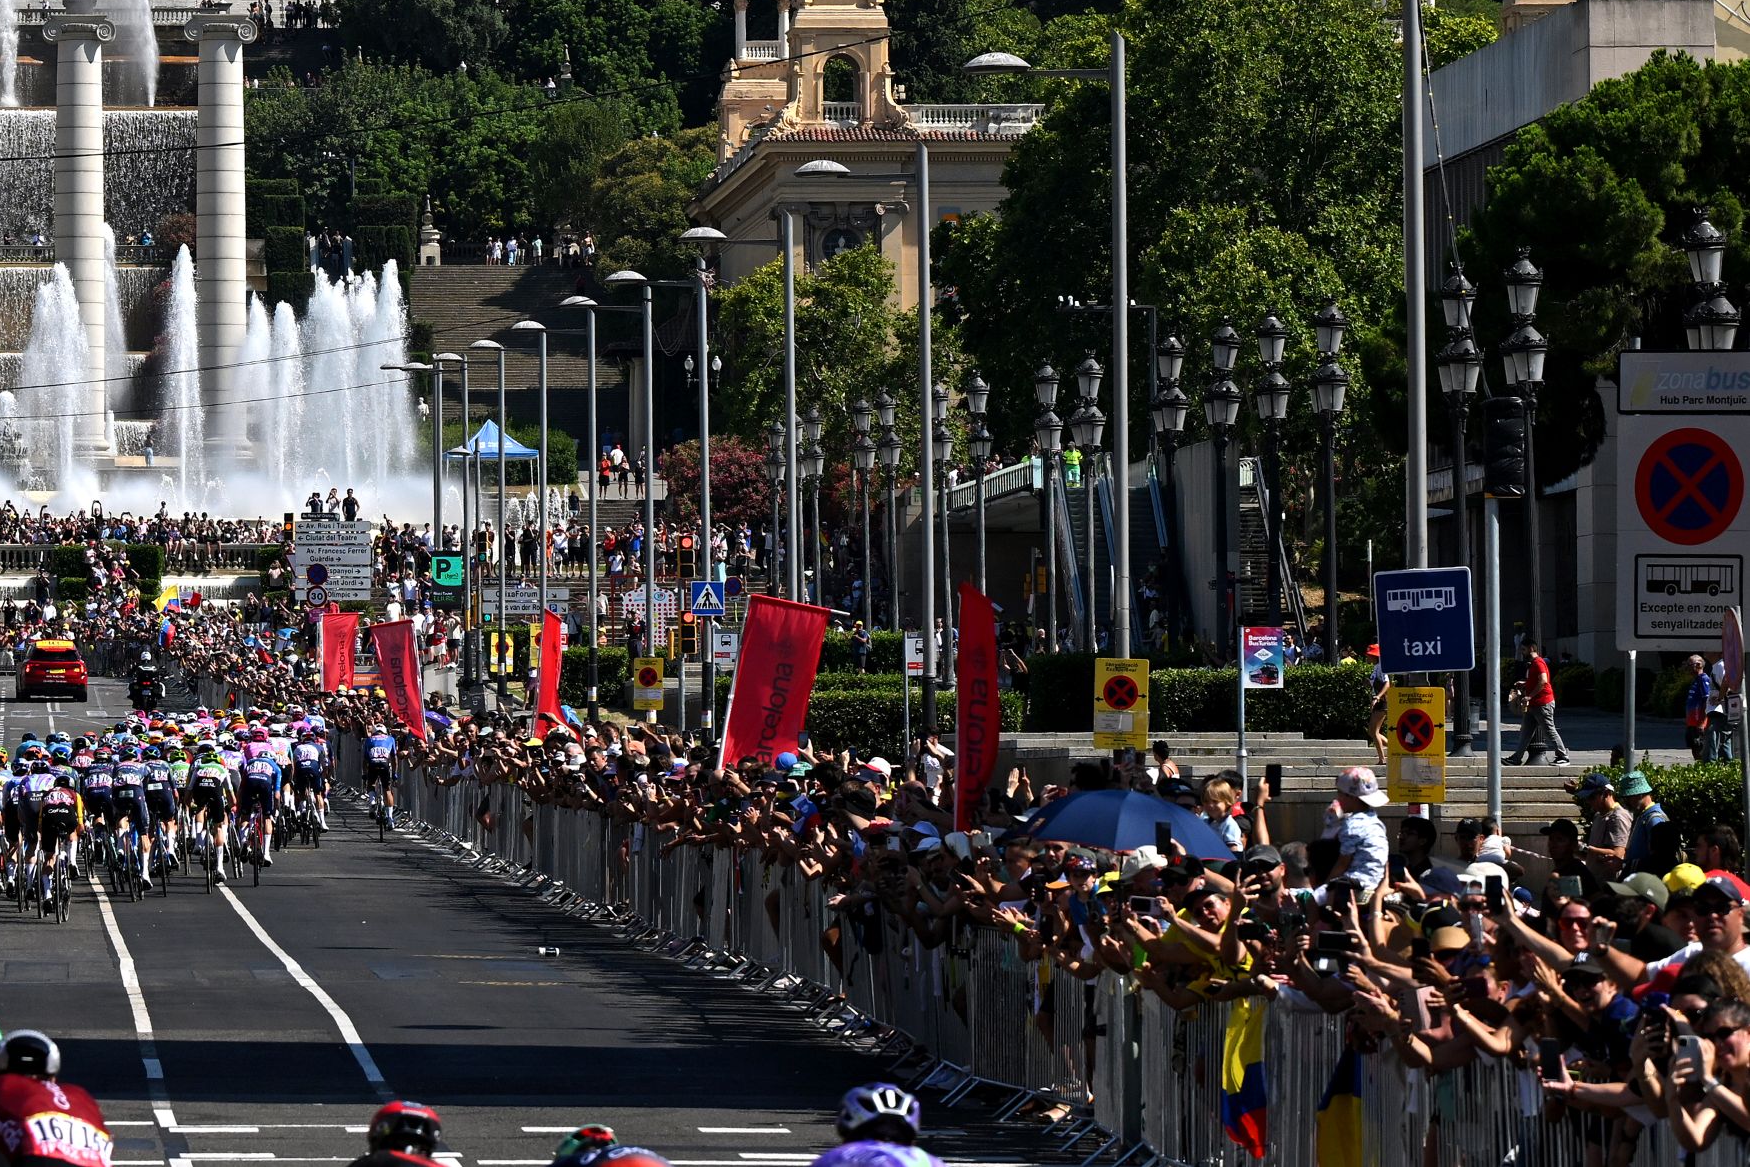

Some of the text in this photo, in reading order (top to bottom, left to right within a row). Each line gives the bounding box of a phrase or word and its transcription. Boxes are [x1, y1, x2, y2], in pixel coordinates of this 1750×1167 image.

[1660, 395, 1680, 405] Hub
[1683, 395, 1704, 405] Parc
[318, 547, 346, 555] Francesc
[436, 559, 451, 579] P
[1640, 602, 1732, 614] Excepte en zone
[1403, 635, 1442, 656] taxi
[757, 662, 795, 769] arcelona
[34, 1117, 75, 1144] 167
